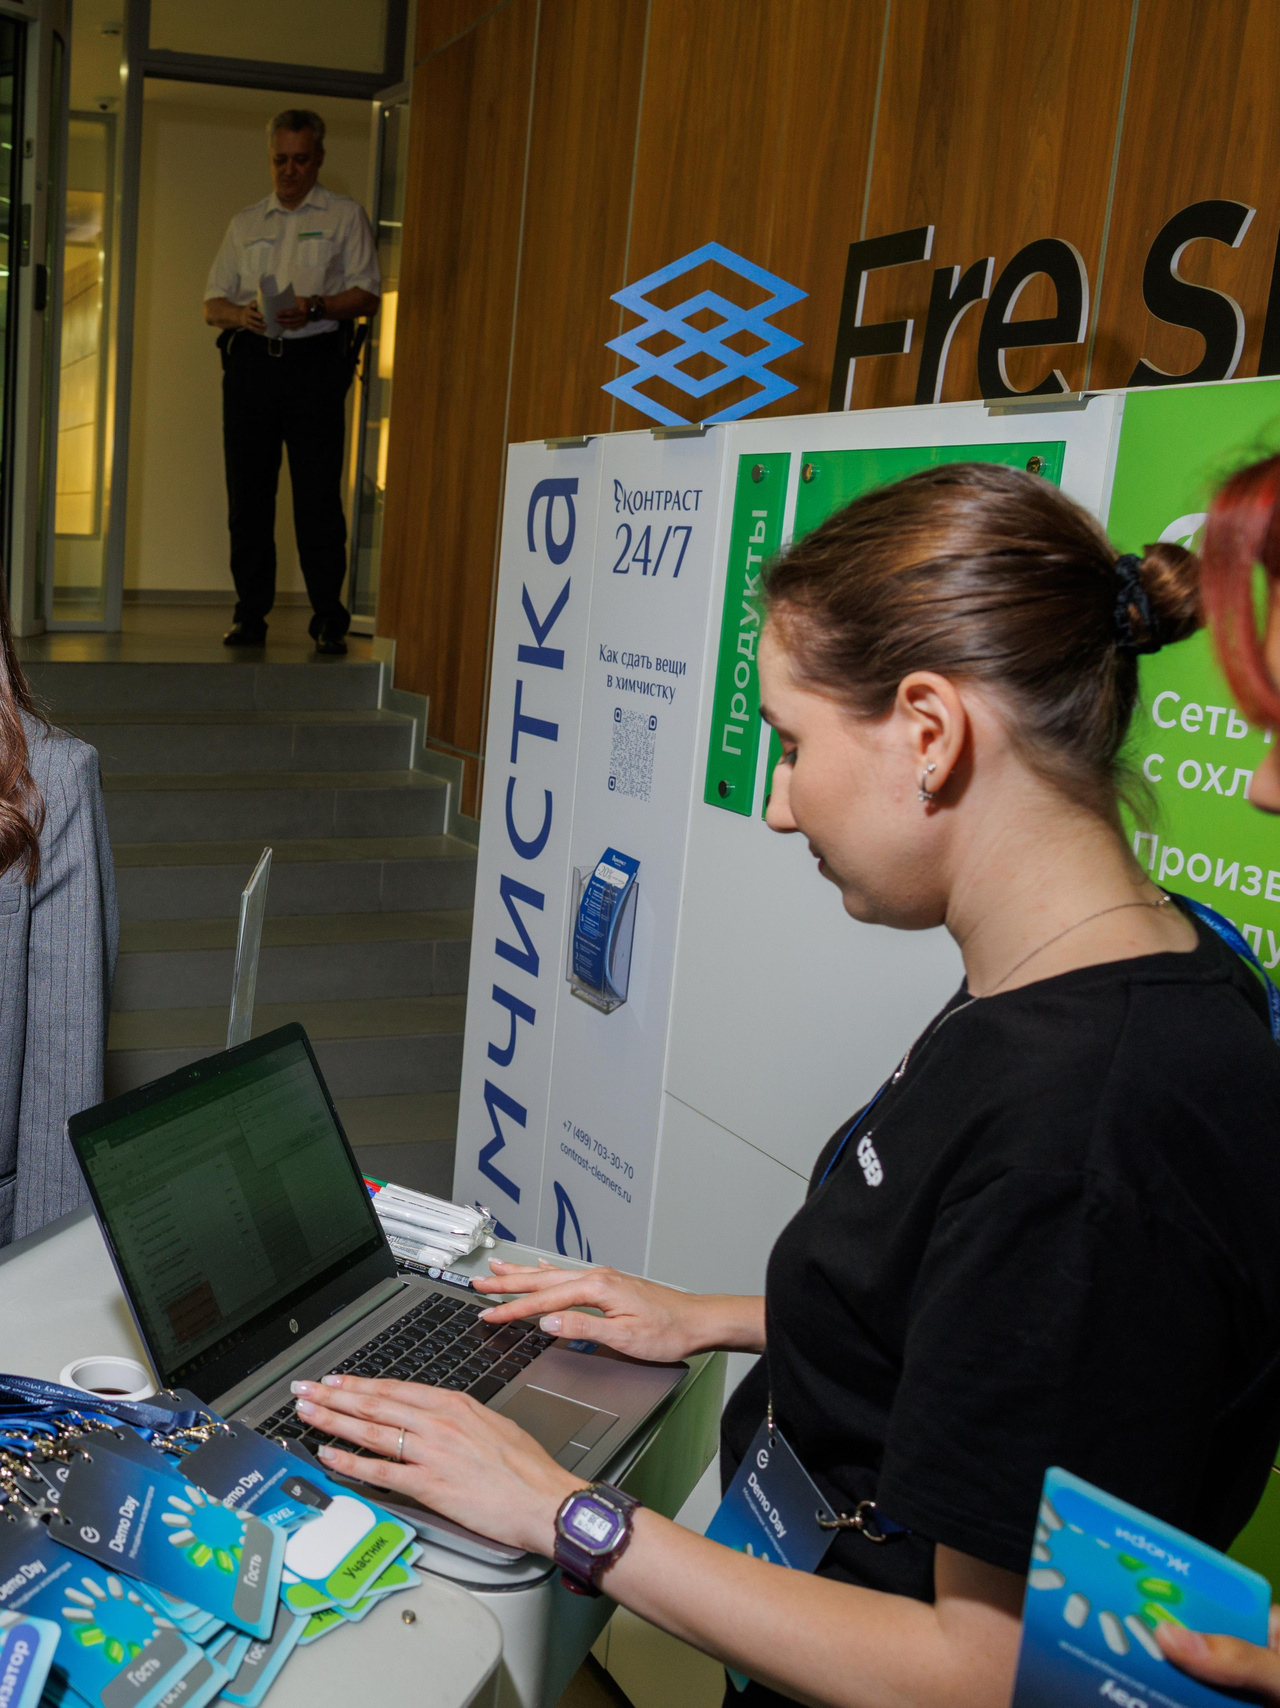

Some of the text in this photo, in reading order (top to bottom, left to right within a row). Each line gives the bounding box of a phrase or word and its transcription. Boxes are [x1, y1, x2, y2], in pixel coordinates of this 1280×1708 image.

[623, 489, 703, 515] КОНТРАСТ
[613, 523, 693, 578] 24/7
[722, 510, 768, 756] Продукты
[599, 644, 686, 676] Как сдать вещи
[607, 675, 676, 705] в химчистку
[1151, 690, 1248, 741] Сеть
[1176, 759, 1254, 799] охл
[562, 1120, 634, 1179] +7 (499) 703-30-70
[560, 1142, 632, 1203] contrast-cleaners.ru
[222, 1469, 264, 1509] emo Day
[291, 1485, 302, 1497] UP
[748, 1472, 787, 1538] Demo Day
[109, 1495, 140, 1553] Demo Day
[268, 1507, 295, 1525] EVEL
[18, 1559, 47, 1587] Day
[243, 1554, 262, 1588] Гость
[342, 1536, 389, 1579] Участник
[127, 1657, 161, 1688] Гость
